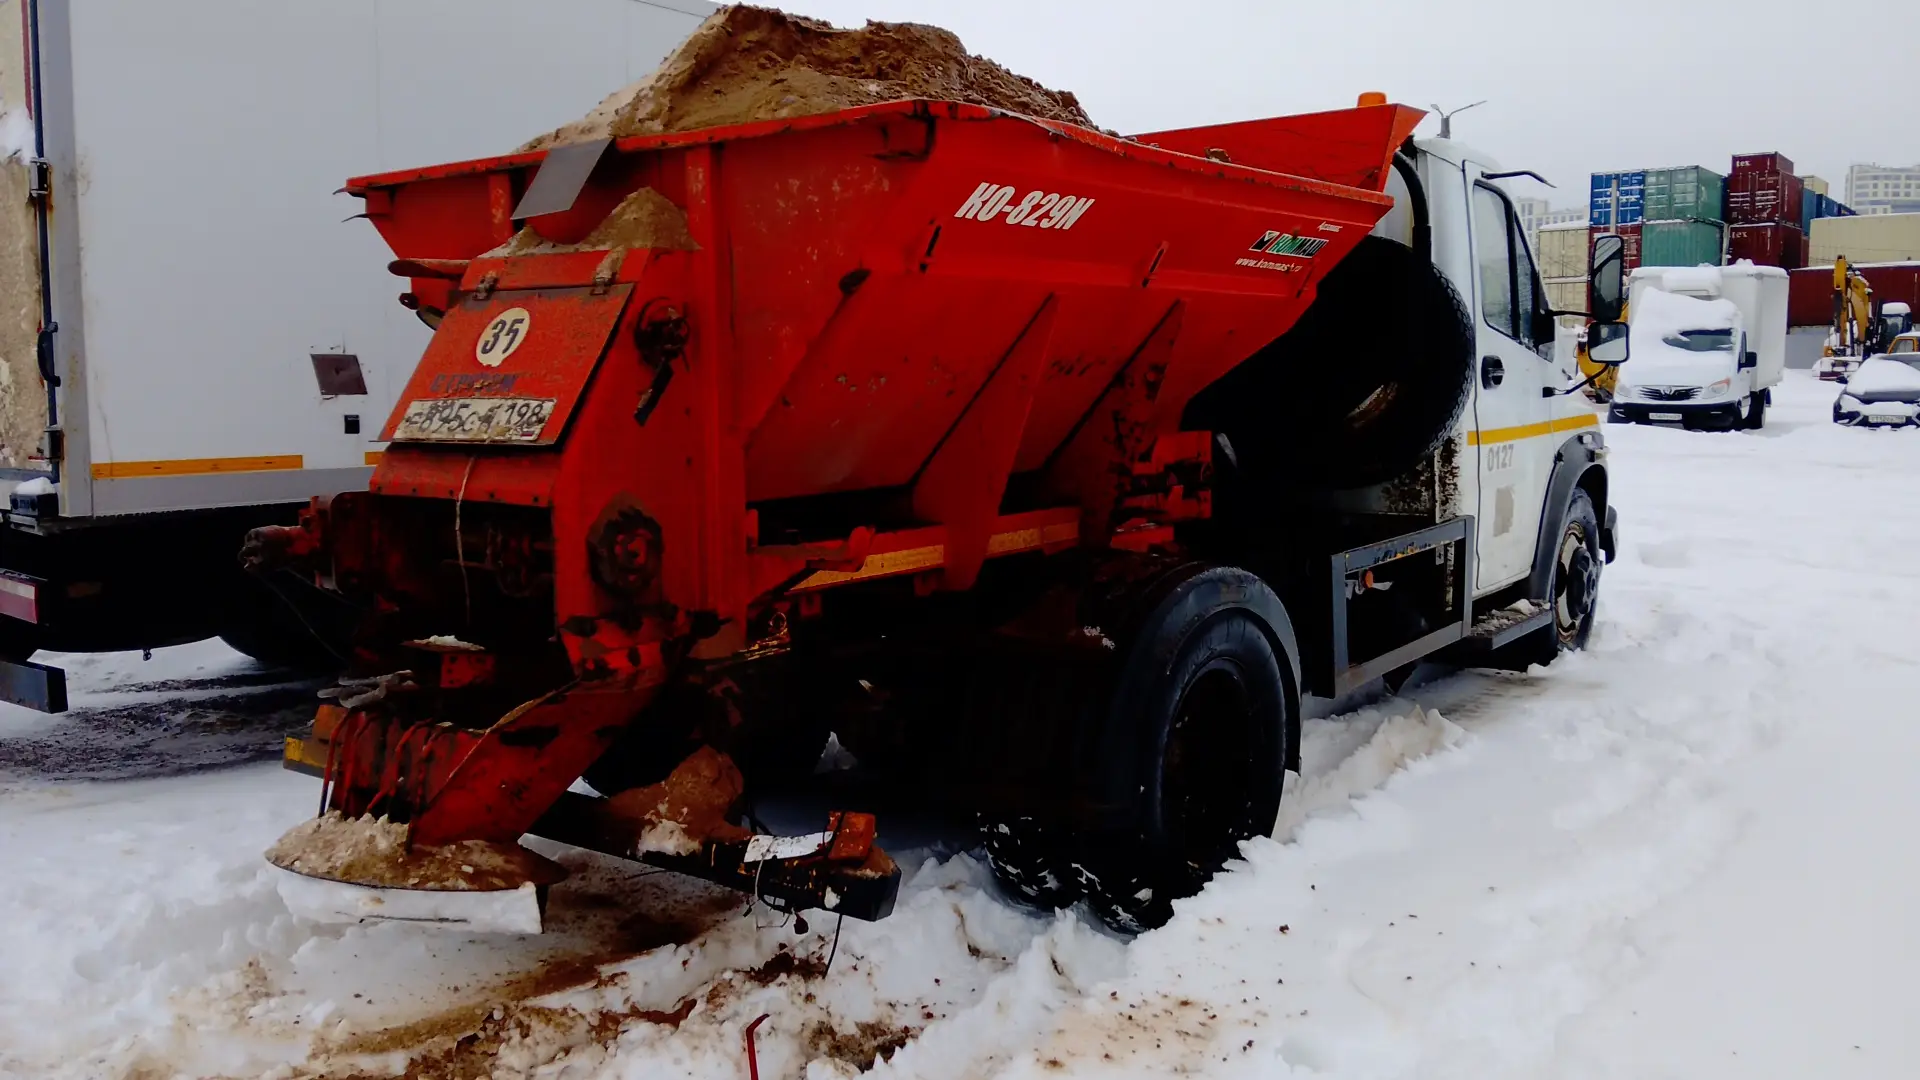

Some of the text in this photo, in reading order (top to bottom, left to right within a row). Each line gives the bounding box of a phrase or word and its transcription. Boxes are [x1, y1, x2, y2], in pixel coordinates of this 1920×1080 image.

[480, 318, 525, 355] 35
[504, 403, 545, 428] 198
[1487, 443, 1514, 472] 0127
